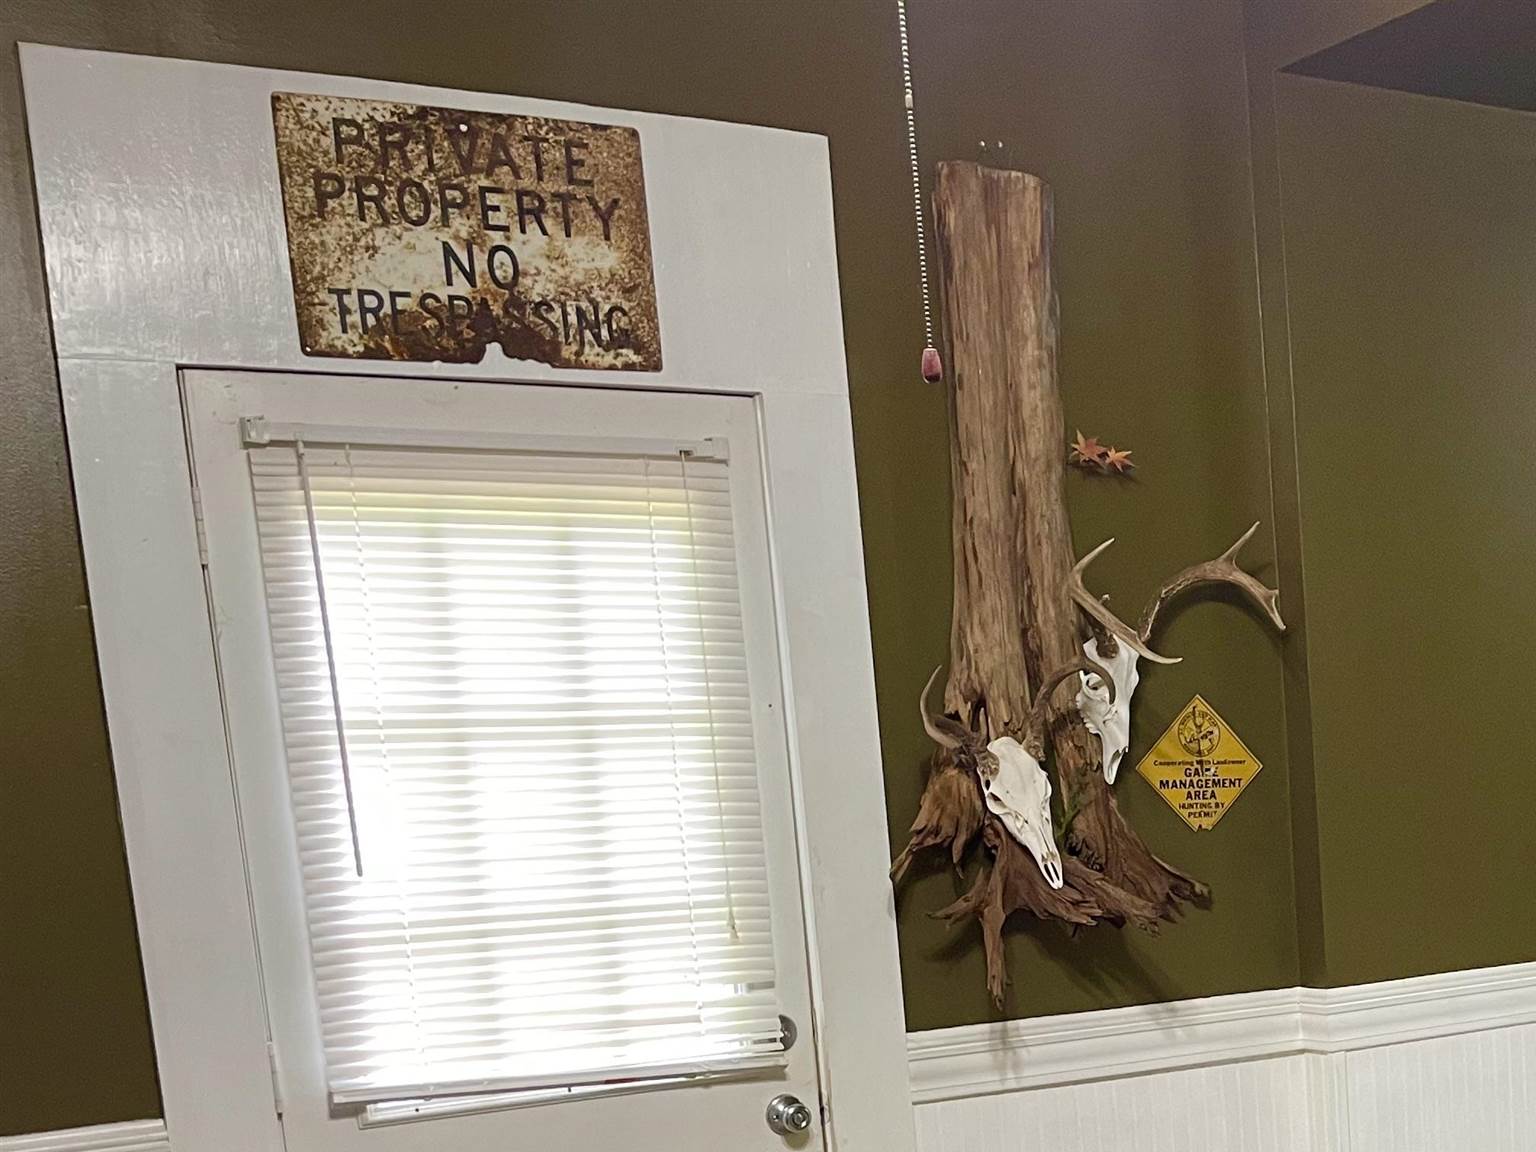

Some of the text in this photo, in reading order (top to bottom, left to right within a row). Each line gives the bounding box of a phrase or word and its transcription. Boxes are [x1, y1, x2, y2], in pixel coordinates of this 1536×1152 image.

[332, 117, 595, 188] PRIVATE
[311, 171, 620, 242] PROPERTY
[441, 240, 520, 291] NO
[327, 288, 638, 356] TRESPASSING
[1159, 778, 1242, 789] MANAGEMENT
[1186, 790, 1217, 800] AREA
[1187, 810, 1218, 818] PERMIT
